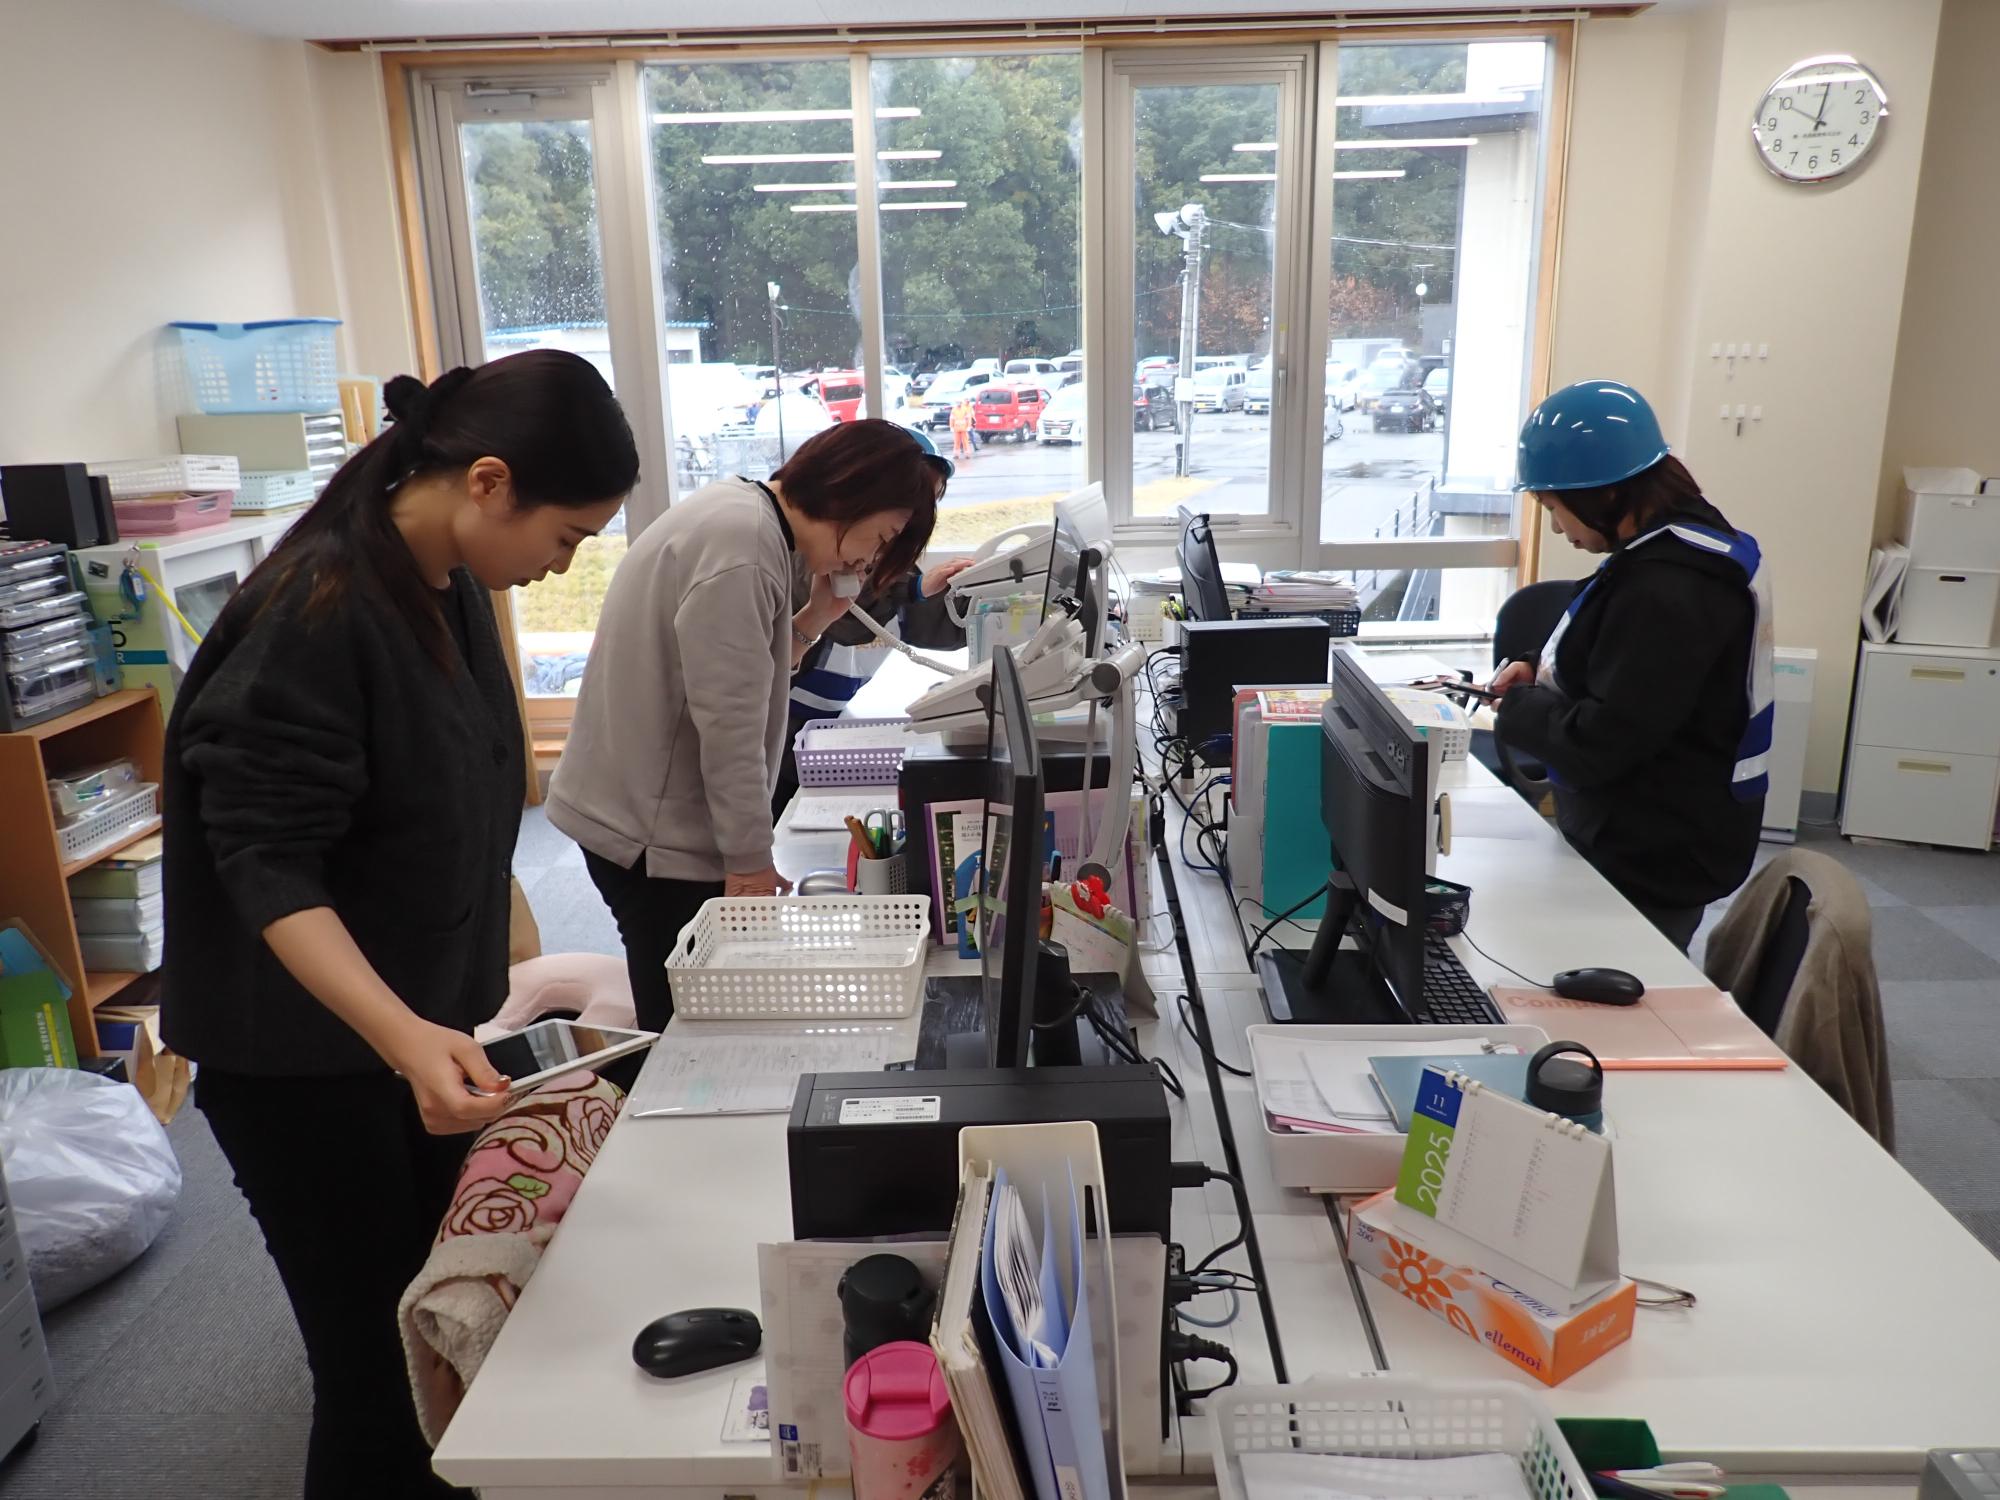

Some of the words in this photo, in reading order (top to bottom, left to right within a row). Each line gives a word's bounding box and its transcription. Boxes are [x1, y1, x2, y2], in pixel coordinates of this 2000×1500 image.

[1778, 96, 1793, 111] 10
[1854, 90, 1865, 105] 2
[1767, 117, 1777, 132] 9
[1859, 110, 1870, 125] 3
[1772, 138, 1782, 152] 8
[1848, 134, 1858, 148] 4
[1789, 151, 1799, 166] 7
[1808, 156, 1818, 170] 6
[1830, 149, 1840, 163] 5
[1432, 1094, 1445, 1108] 11
[1416, 1131, 1453, 1206] 2025
[1484, 1330, 1543, 1373] ellemoi
